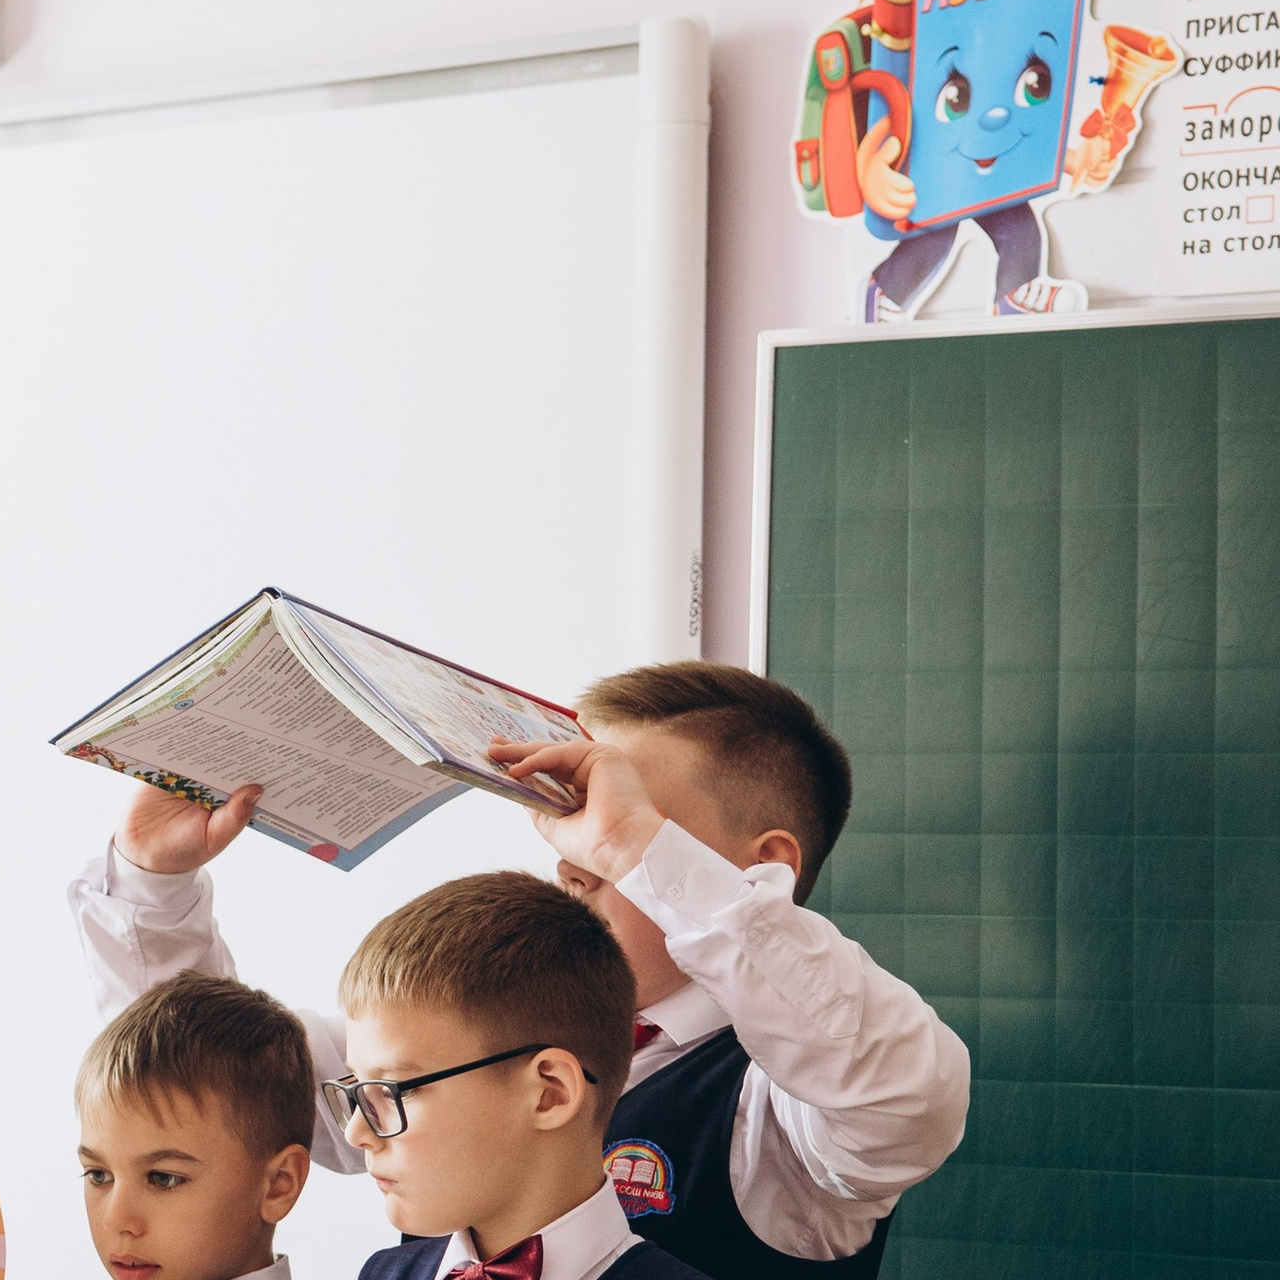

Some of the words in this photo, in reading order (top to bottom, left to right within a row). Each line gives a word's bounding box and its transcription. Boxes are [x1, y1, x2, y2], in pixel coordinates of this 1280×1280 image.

[1186, 11, 1280, 38] ПРИСТА
[1185, 115, 1280, 142] замор
[1183, 166, 1280, 191] ОКОНЧА
[1183, 205, 1241, 223] стол
[1183, 238, 1211, 255] на
[1223, 234, 1280, 252] стол
